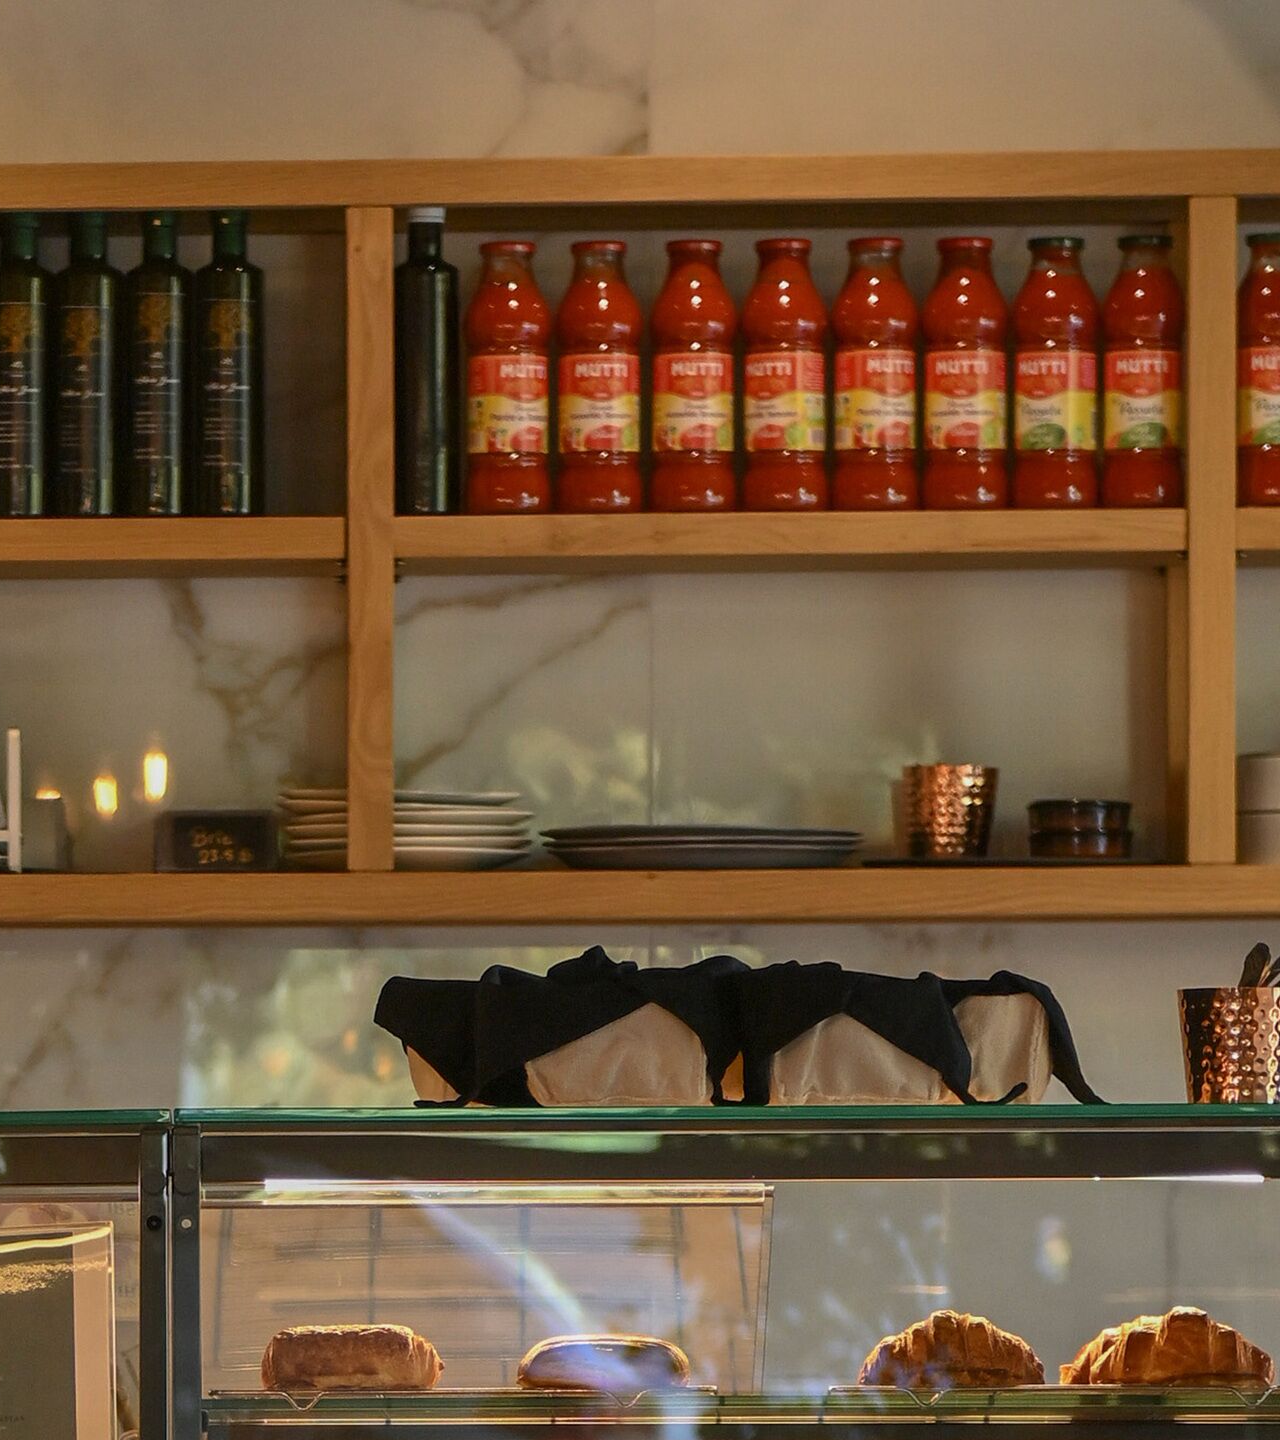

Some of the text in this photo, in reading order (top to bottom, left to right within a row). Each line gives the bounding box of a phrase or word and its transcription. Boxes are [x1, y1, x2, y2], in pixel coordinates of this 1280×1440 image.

[574, 362, 629, 378] MUTTI
[671, 361, 724, 378] MUTTI
[934, 357, 989, 374] MUTTI
[1018, 357, 1067, 375] MUTTI
[1116, 357, 1169, 374] MUTTI
